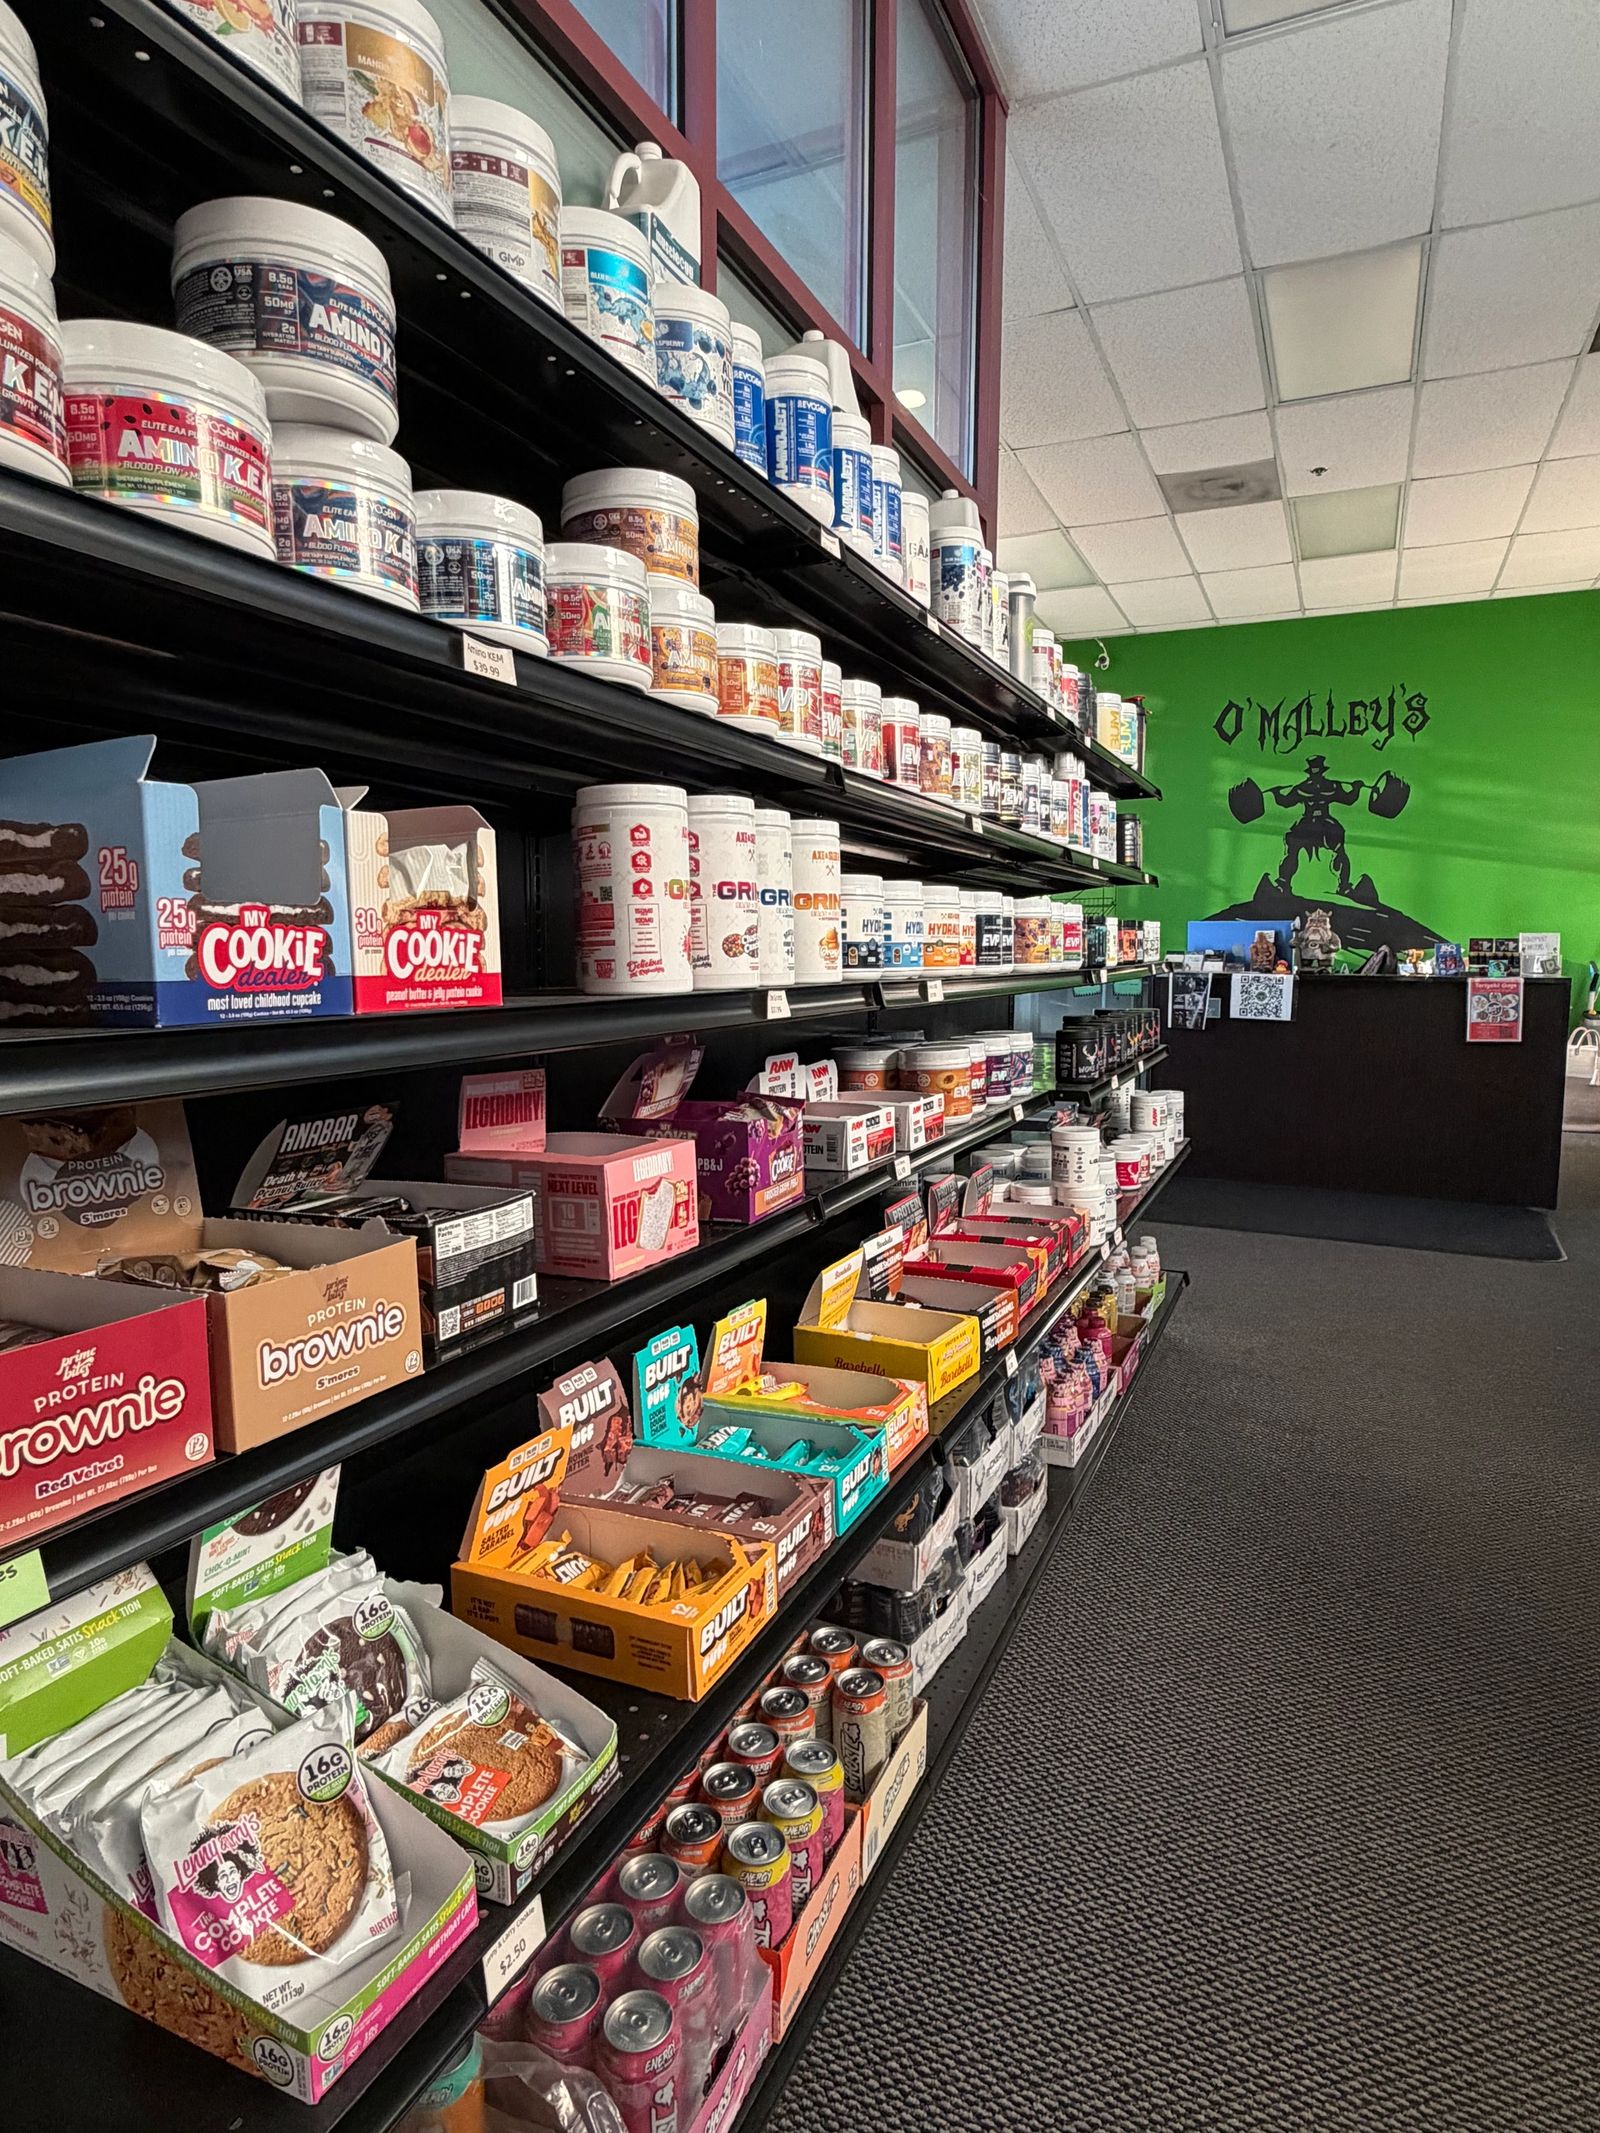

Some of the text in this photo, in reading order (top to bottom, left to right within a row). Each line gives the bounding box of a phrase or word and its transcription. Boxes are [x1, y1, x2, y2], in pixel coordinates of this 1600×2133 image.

[309, 304, 382, 362] AMINO
[141, 419, 186, 435] ELITE EAA
[117, 429, 219, 475] AMINO
[123, 461, 181, 476] BLOOD FLOW
[467, 645, 504, 664] Amino KEM
[472, 660, 500, 679] $39.99
[1213, 682, 1431, 755] O'MALLEY'S
[98, 846, 139, 890] 25g
[101, 887, 135, 911] protein
[157, 897, 196, 933] 25g
[243, 909, 268, 928] MY
[355, 909, 382, 935] 30g
[419, 912, 439, 928] MY
[159, 929, 193, 948] protein
[357, 933, 384, 948] protein
[238, 961, 310, 987] dealer
[414, 962, 471, 983] dealer
[207, 990, 322, 1011] most loved childhood cupcake
[769, 1058, 794, 1075] RAW
[810, 1064, 829, 1079] RAW
[768, 1083, 787, 1095] PROTEIN
[279, 1114, 359, 1153] ANABAR
[67, 1153, 123, 1173] PROTEIN
[27, 1160, 166, 1214] brownie
[252, 1178, 323, 1201] Peanut Butter
[263, 1171, 296, 1187] Death
[547, 1180, 599, 1196] NEXT LEVEL
[80, 1207, 128, 1225] S'mores
[891, 1197, 922, 1221] PROTEIN
[306, 1297, 367, 1328] PROTEIN
[260, 1301, 405, 1386] brownie
[718, 1316, 763, 1355] BUILT
[55, 1346, 97, 1377] prime
[645, 1344, 692, 1391] BUILT
[834, 1356, 886, 1377] Barebells
[940, 1353, 974, 1388] Barebells
[315, 1365, 360, 1391] S'mores
[33, 1372, 125, 1414] PROTEIN
[558, 1378, 613, 1429] BUILT
[646, 1382, 670, 1410] PUFF
[0, 1375, 186, 1477] rownie
[571, 1423, 595, 1450] UFF
[35, 1453, 125, 1500] Red Velvet
[486, 1448, 563, 1513] BUILT
[841, 1452, 872, 1500] BUILT
[482, 1499, 522, 1534] PUFF
[479, 1528, 515, 1556] CARAMEL
[480, 1523, 510, 1545] SALTED
[777, 1510, 813, 1564] BUILT
[203, 1546, 251, 1577] CHOC-O-MINT
[211, 1570, 255, 1602] SOFT-BAKED
[256, 1558, 275, 1577] SATIS
[301, 1533, 318, 1549] TION
[778, 1552, 798, 1583] PUFF
[55, 1629, 84, 1649] SATIS
[120, 1599, 142, 1620] TION
[359, 1600, 389, 1623] 16G
[360, 1608, 393, 1633] PROTEIN
[700, 1582, 749, 1655] BUILT
[702, 1634, 728, 1676] PUFF
[305, 1751, 343, 1781] 16G
[306, 1763, 349, 1795] PROTEIN
[738, 1869, 773, 1884] ENERGY
[192, 1910, 215, 1930] The
[194, 1878, 282, 1952] COMPLETE
[368, 1908, 400, 1937] BIRTHD
[428, 1894, 476, 1959] BIRTHDAY CAKE
[515, 1906, 536, 1929] Cookie
[376, 1941, 421, 1993] SOFT-BAKED
[420, 1921, 440, 1947] SATIS
[499, 1937, 528, 1977] $2.50
[262, 1979, 293, 2004] NET WT.
[280, 1982, 306, 2008] (113g)
[323, 2020, 350, 2047] 16G
[259, 2043, 288, 2070] 16G
[644, 2039, 677, 2075] ENERGY
